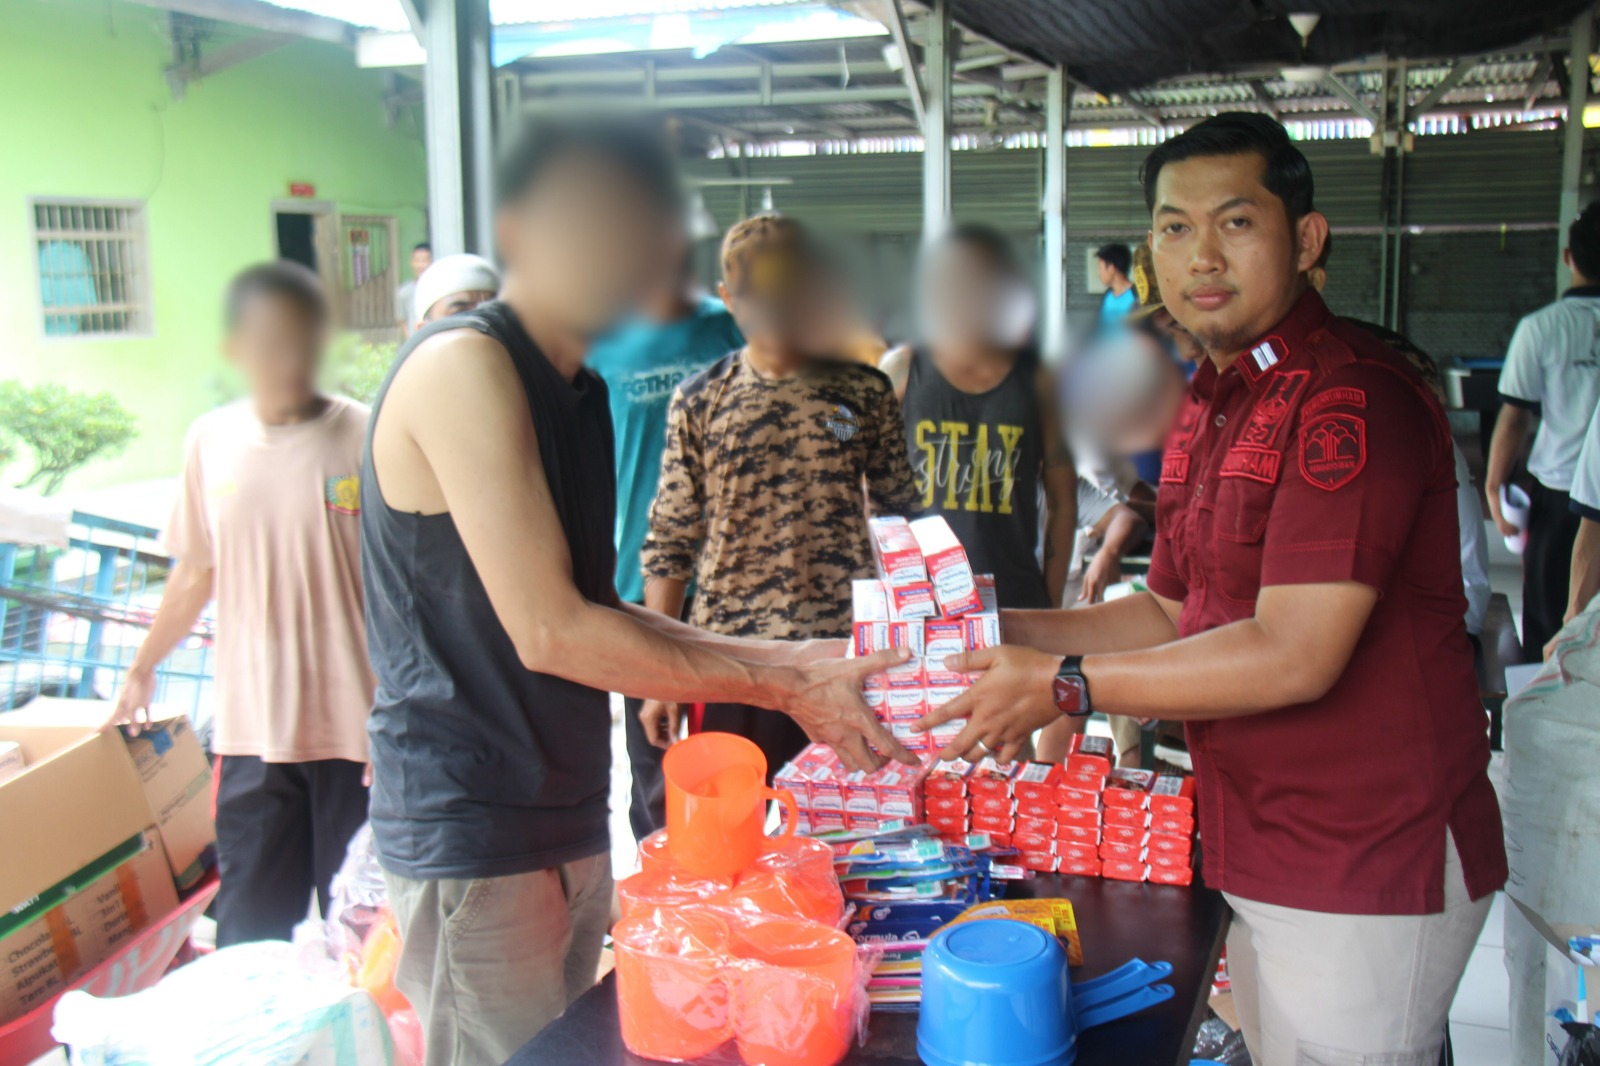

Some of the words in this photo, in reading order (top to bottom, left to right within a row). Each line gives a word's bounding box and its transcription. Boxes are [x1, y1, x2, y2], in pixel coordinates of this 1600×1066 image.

[915, 420, 1024, 514] STAY
[9, 929, 54, 962] Chocola
[11, 944, 57, 977] Strawbe
